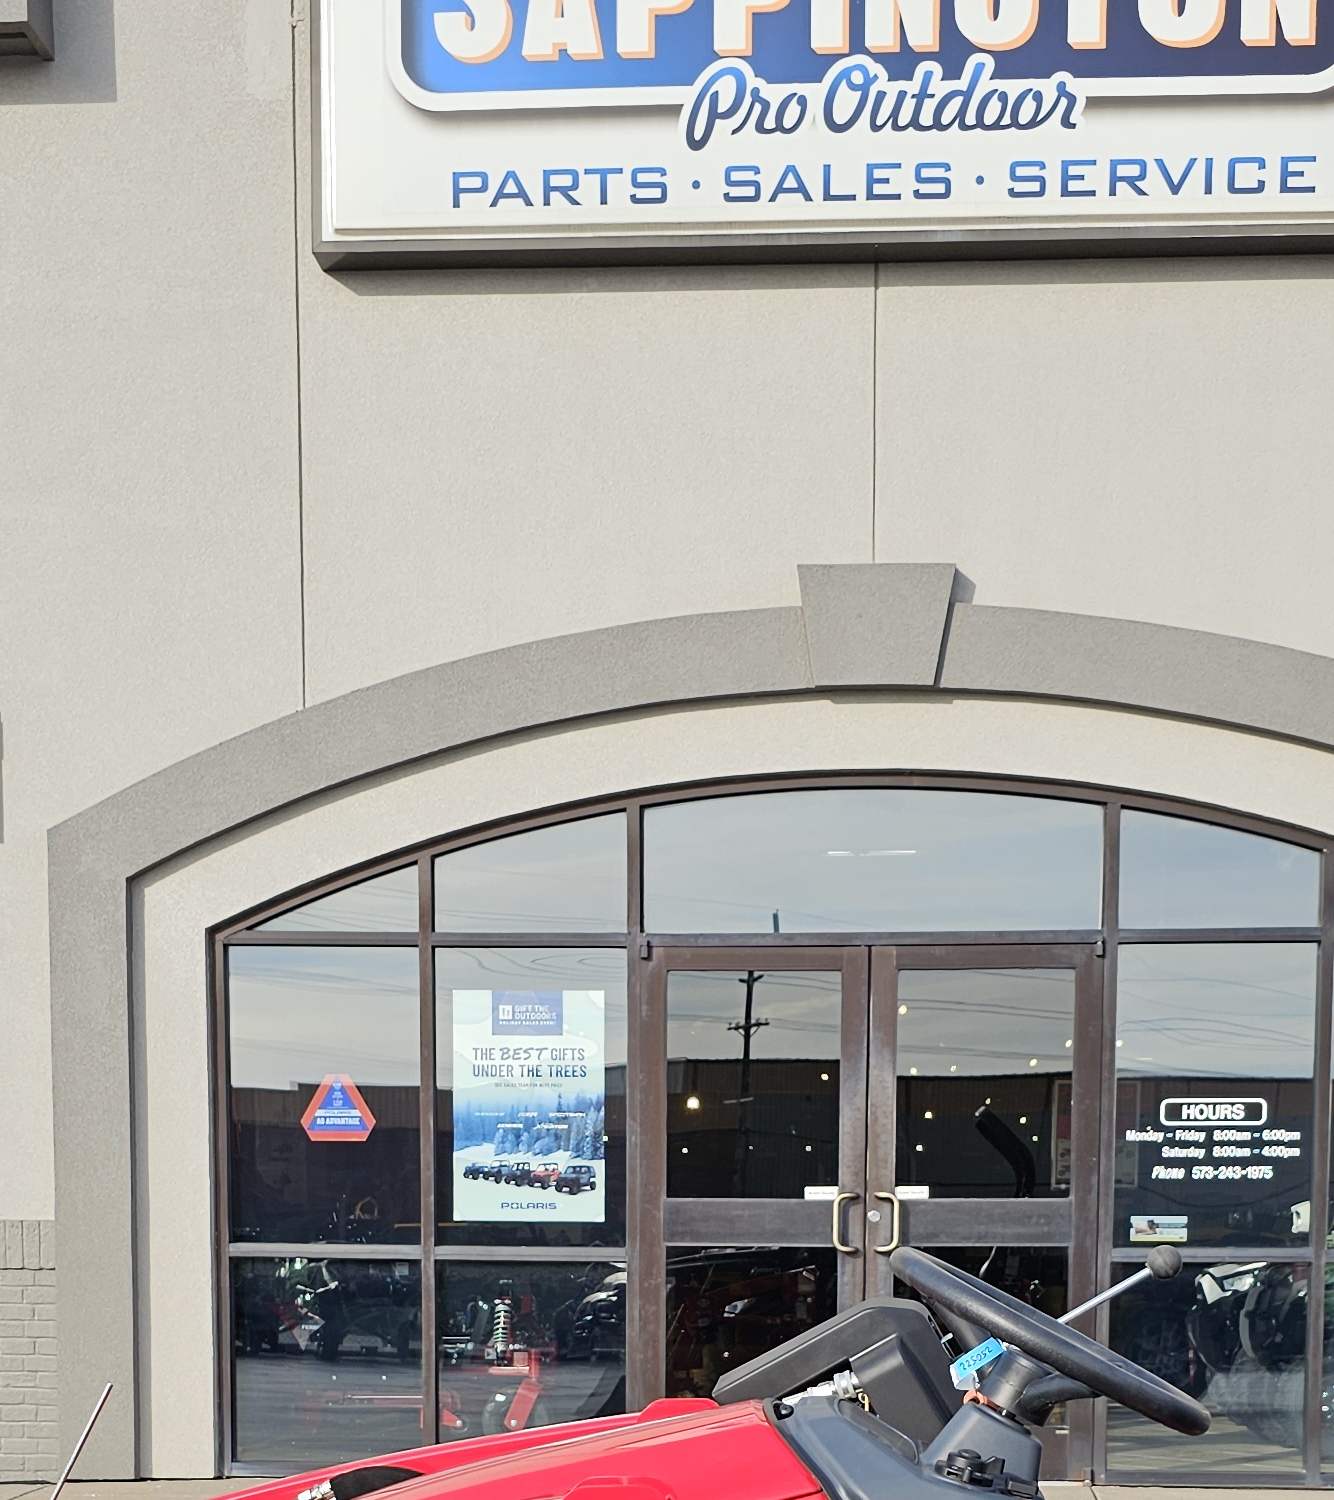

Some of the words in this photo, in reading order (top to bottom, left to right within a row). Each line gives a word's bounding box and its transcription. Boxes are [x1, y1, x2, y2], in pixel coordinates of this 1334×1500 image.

[685, 66, 808, 152] Pro
[823, 61, 1078, 134] Outdoor
[451, 167, 668, 208] PARTS
[723, 162, 952, 203] SALES
[1007, 155, 1317, 199] SERVICE
[472, 1047, 496, 1061] THE
[499, 1047, 549, 1061] BEST
[550, 1047, 585, 1061] GIFTS
[472, 1064, 514, 1078] UNDER
[520, 1064, 543, 1078] THE
[547, 1064, 587, 1078] TREES
[1181, 1104, 1245, 1120] HOURS
[1125, 1129, 1164, 1142] Monday
[1175, 1129, 1207, 1142] Friday
[1161, 1146, 1206, 1159] Saturday
[1151, 1166, 1185, 1180] Phone
[1191, 1166, 1274, 1180] 573-243-1975
[500, 1202, 557, 1210] POLARIS
